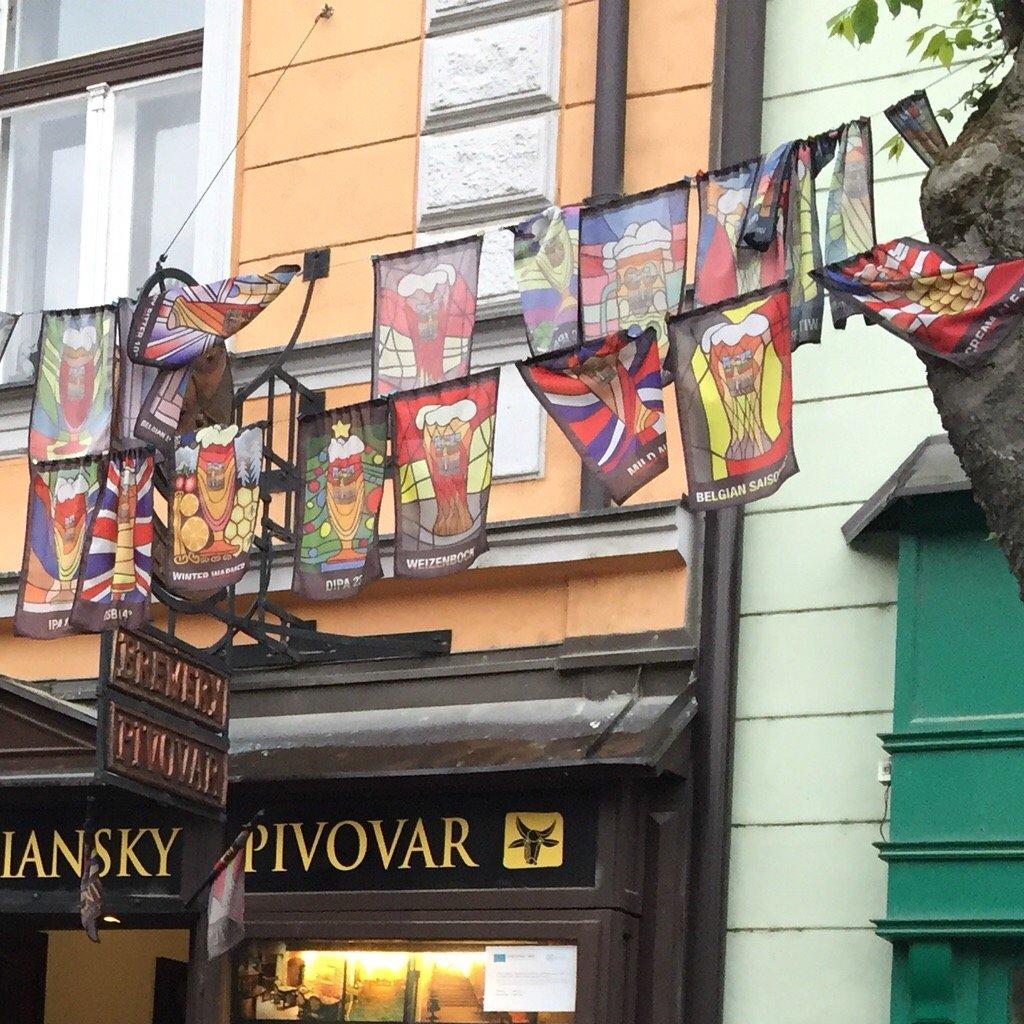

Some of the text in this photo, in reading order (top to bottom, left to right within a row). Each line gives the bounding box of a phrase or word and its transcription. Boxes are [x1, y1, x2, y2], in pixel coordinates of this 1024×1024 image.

[696, 472, 782, 502] BELGIAN SAISO
[406, 547, 476, 570] WEIZENBOCK
[172, 562, 246, 581] WINTER WARMER
[326, 578, 350, 592] DIPA
[244, 816, 479, 873] PIVOVAR
